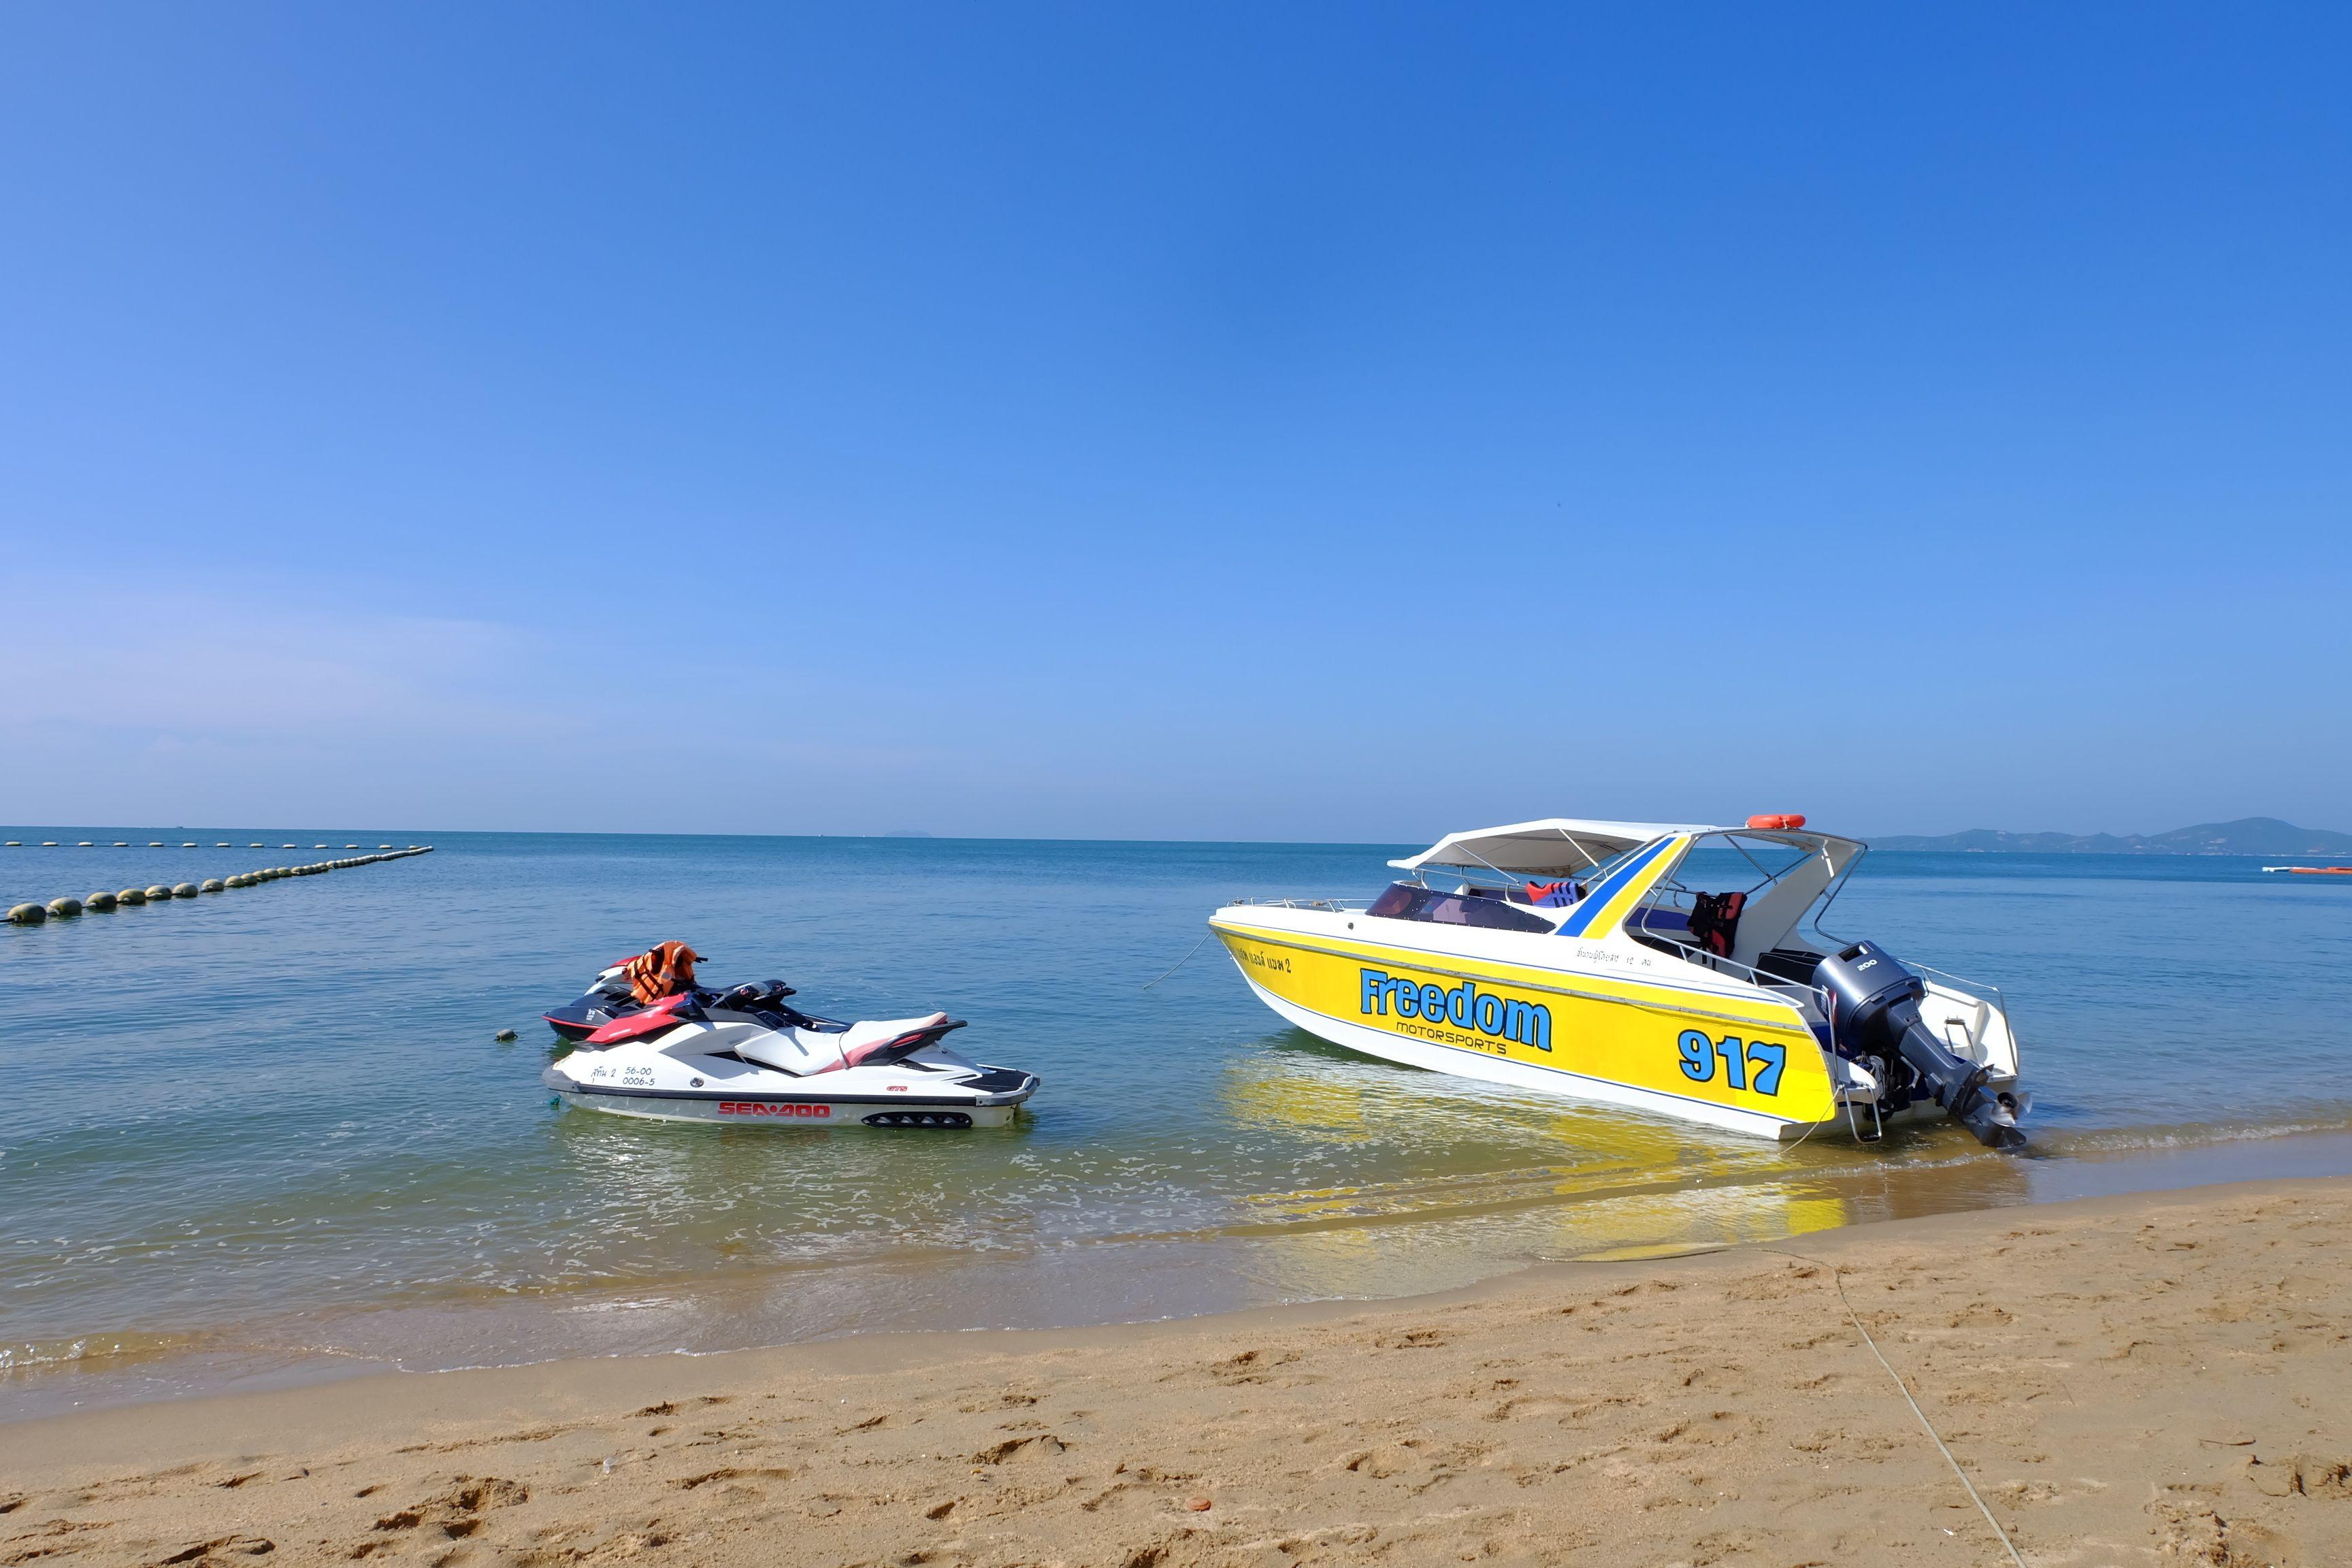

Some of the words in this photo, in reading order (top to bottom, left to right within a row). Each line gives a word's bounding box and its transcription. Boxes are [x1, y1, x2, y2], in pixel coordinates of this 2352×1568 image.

[1285, 958, 1292, 973] 2
[1857, 959, 1878, 971] 200
[1360, 967, 1552, 1052] Freedom
[1396, 1022, 1507, 1055] MOTORSPORTS
[1678, 1029, 1786, 1097] 917
[610, 1068, 617, 1077] 2
[625, 1066, 652, 1075] 56-00
[622, 1077, 655, 1085] 0006-5
